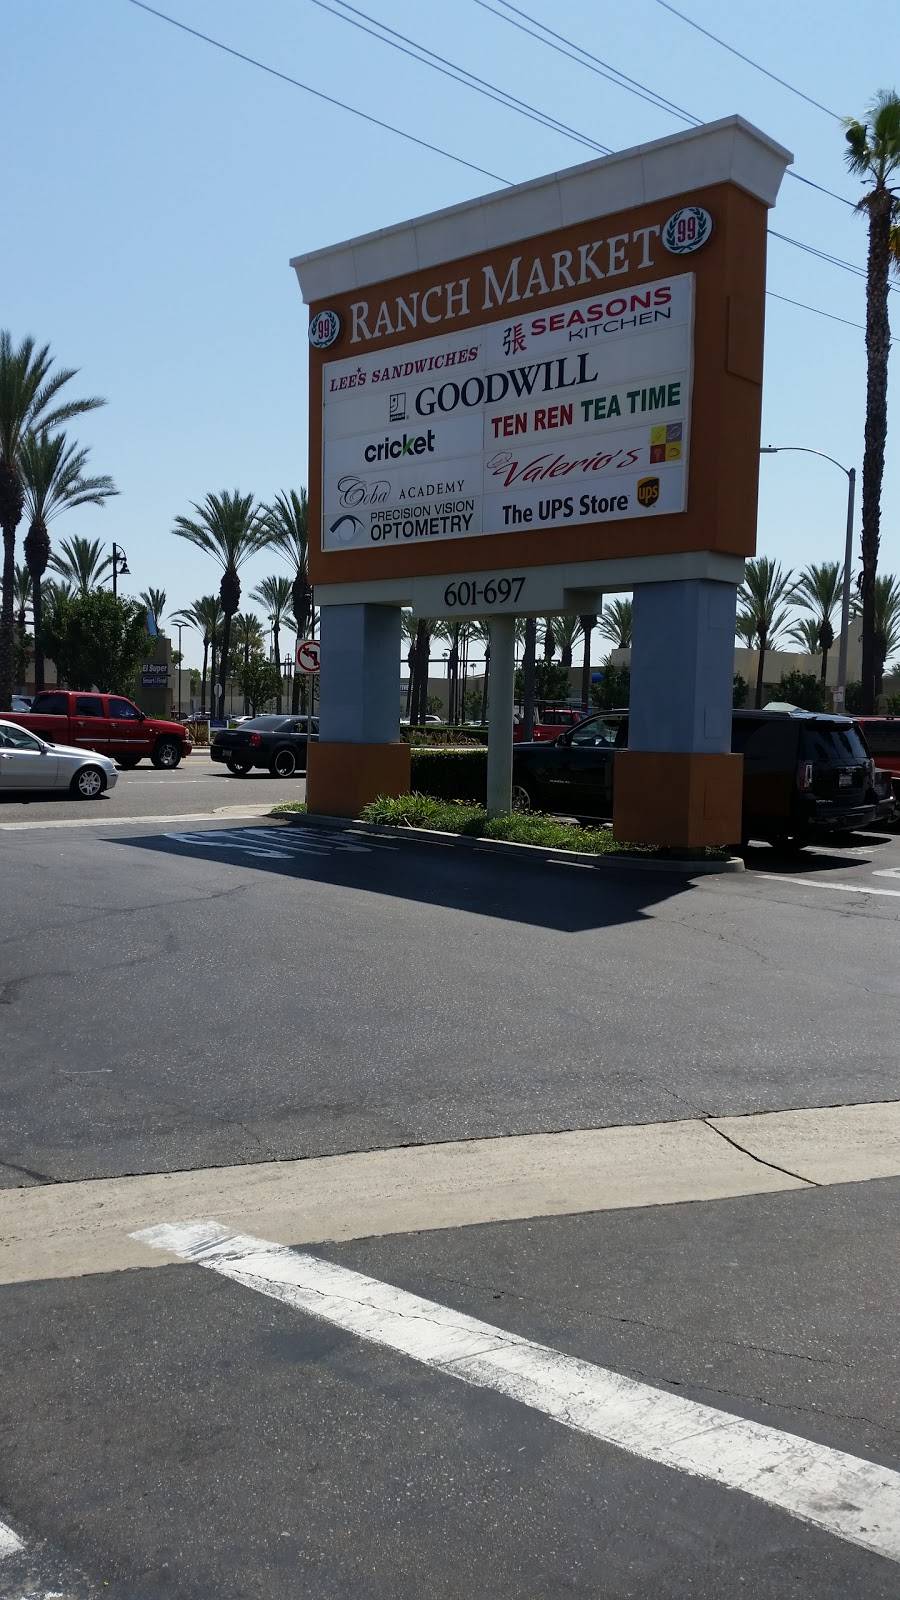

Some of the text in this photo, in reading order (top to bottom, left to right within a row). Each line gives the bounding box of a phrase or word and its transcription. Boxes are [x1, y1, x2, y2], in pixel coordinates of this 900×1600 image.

[678, 216, 696, 243] 99
[349, 225, 662, 344] RANCH MARKET
[530, 286, 673, 336] SEASONS
[568, 307, 672, 342] KITCHEN
[318, 319, 330, 339] 99
[503, 324, 528, 356] 張
[329, 348, 478, 391] LEE'S SANDWICHES
[415, 352, 598, 415] GOODWILL
[491, 382, 681, 439] TEN REN TEA TIME
[364, 429, 435, 463] cricket
[493, 447, 642, 487] Valerio's
[399, 479, 465, 501] ACADEMY
[638, 486, 658, 504] ups
[370, 499, 475, 523] PRECISION VISION
[502, 493, 628, 526] The UPS Store
[370, 513, 473, 542] OPTOMETRY
[444, 577, 526, 607] 601-697
